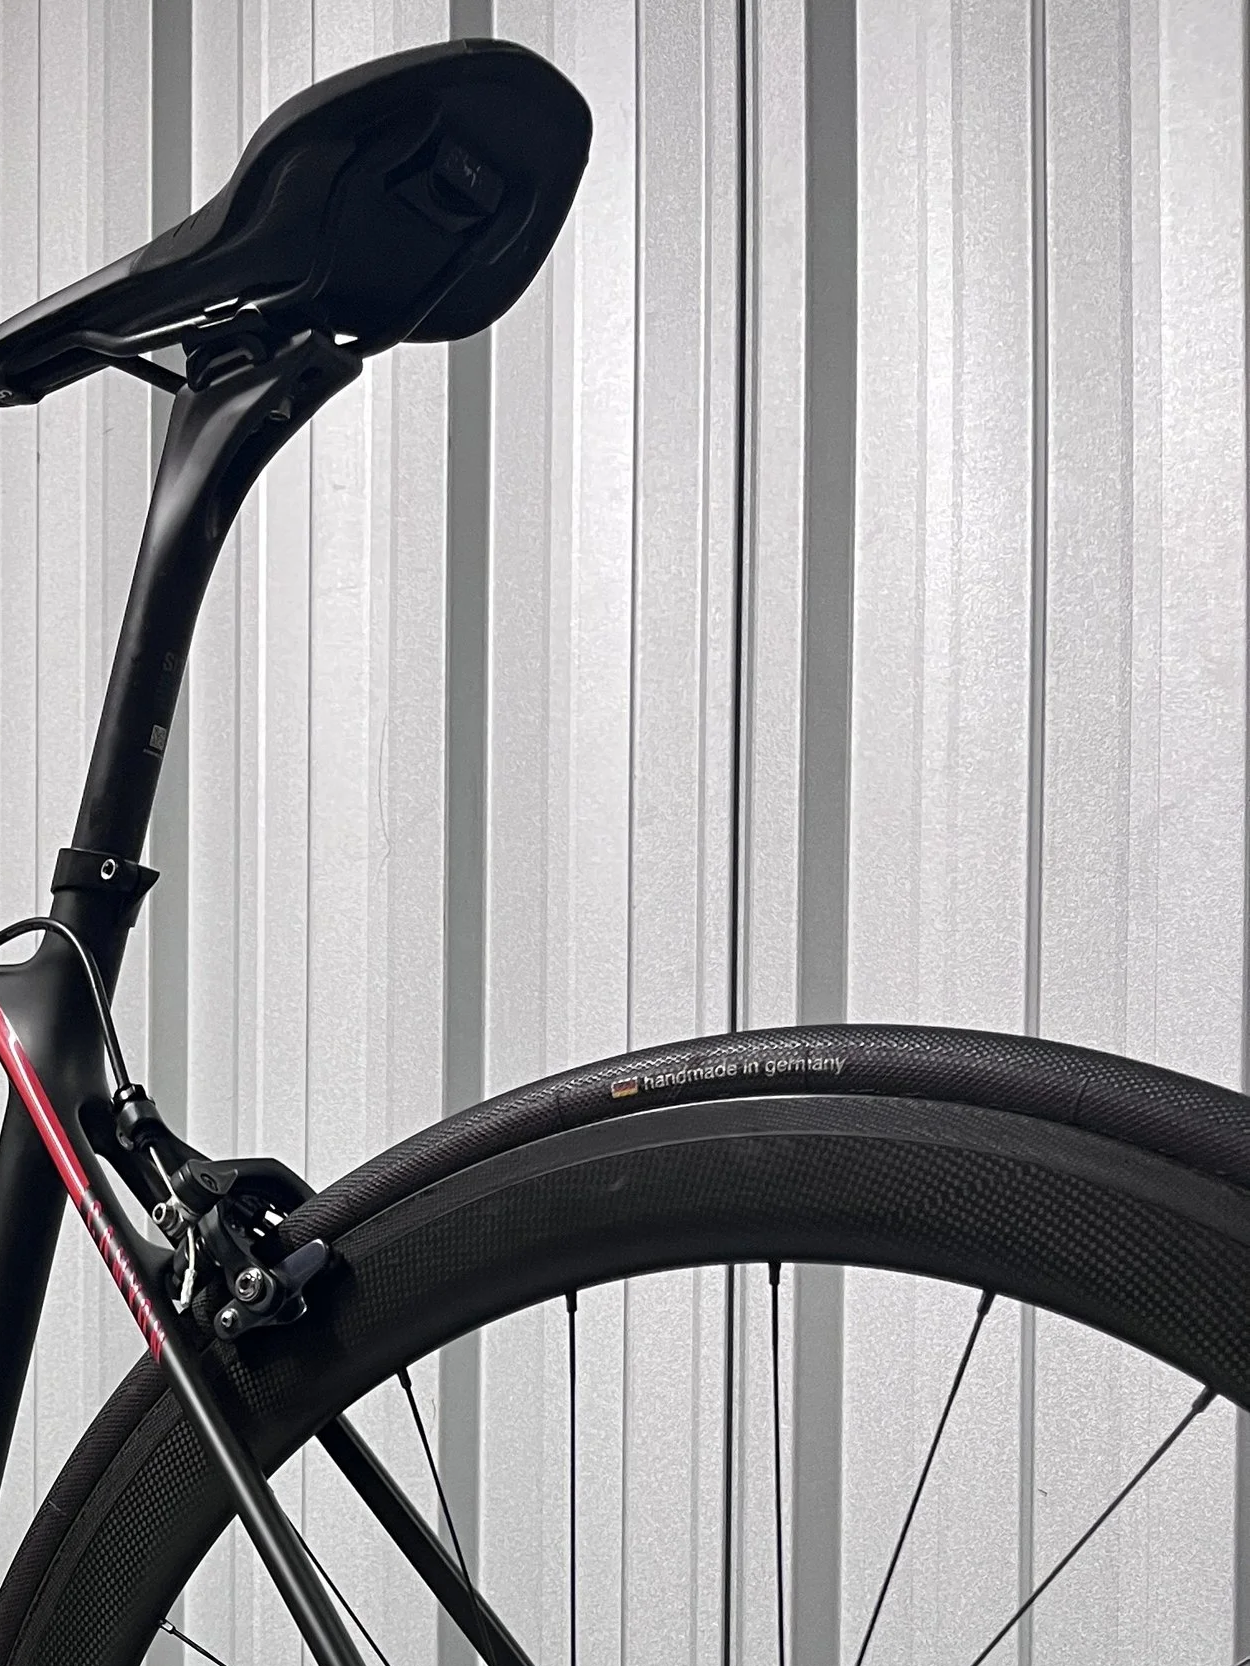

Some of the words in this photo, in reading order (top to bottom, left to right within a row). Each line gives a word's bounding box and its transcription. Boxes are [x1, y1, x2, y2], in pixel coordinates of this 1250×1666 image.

[642, 1061, 738, 1091] handmade
[742, 1059, 760, 1075] in
[764, 1055, 848, 1076] germany
